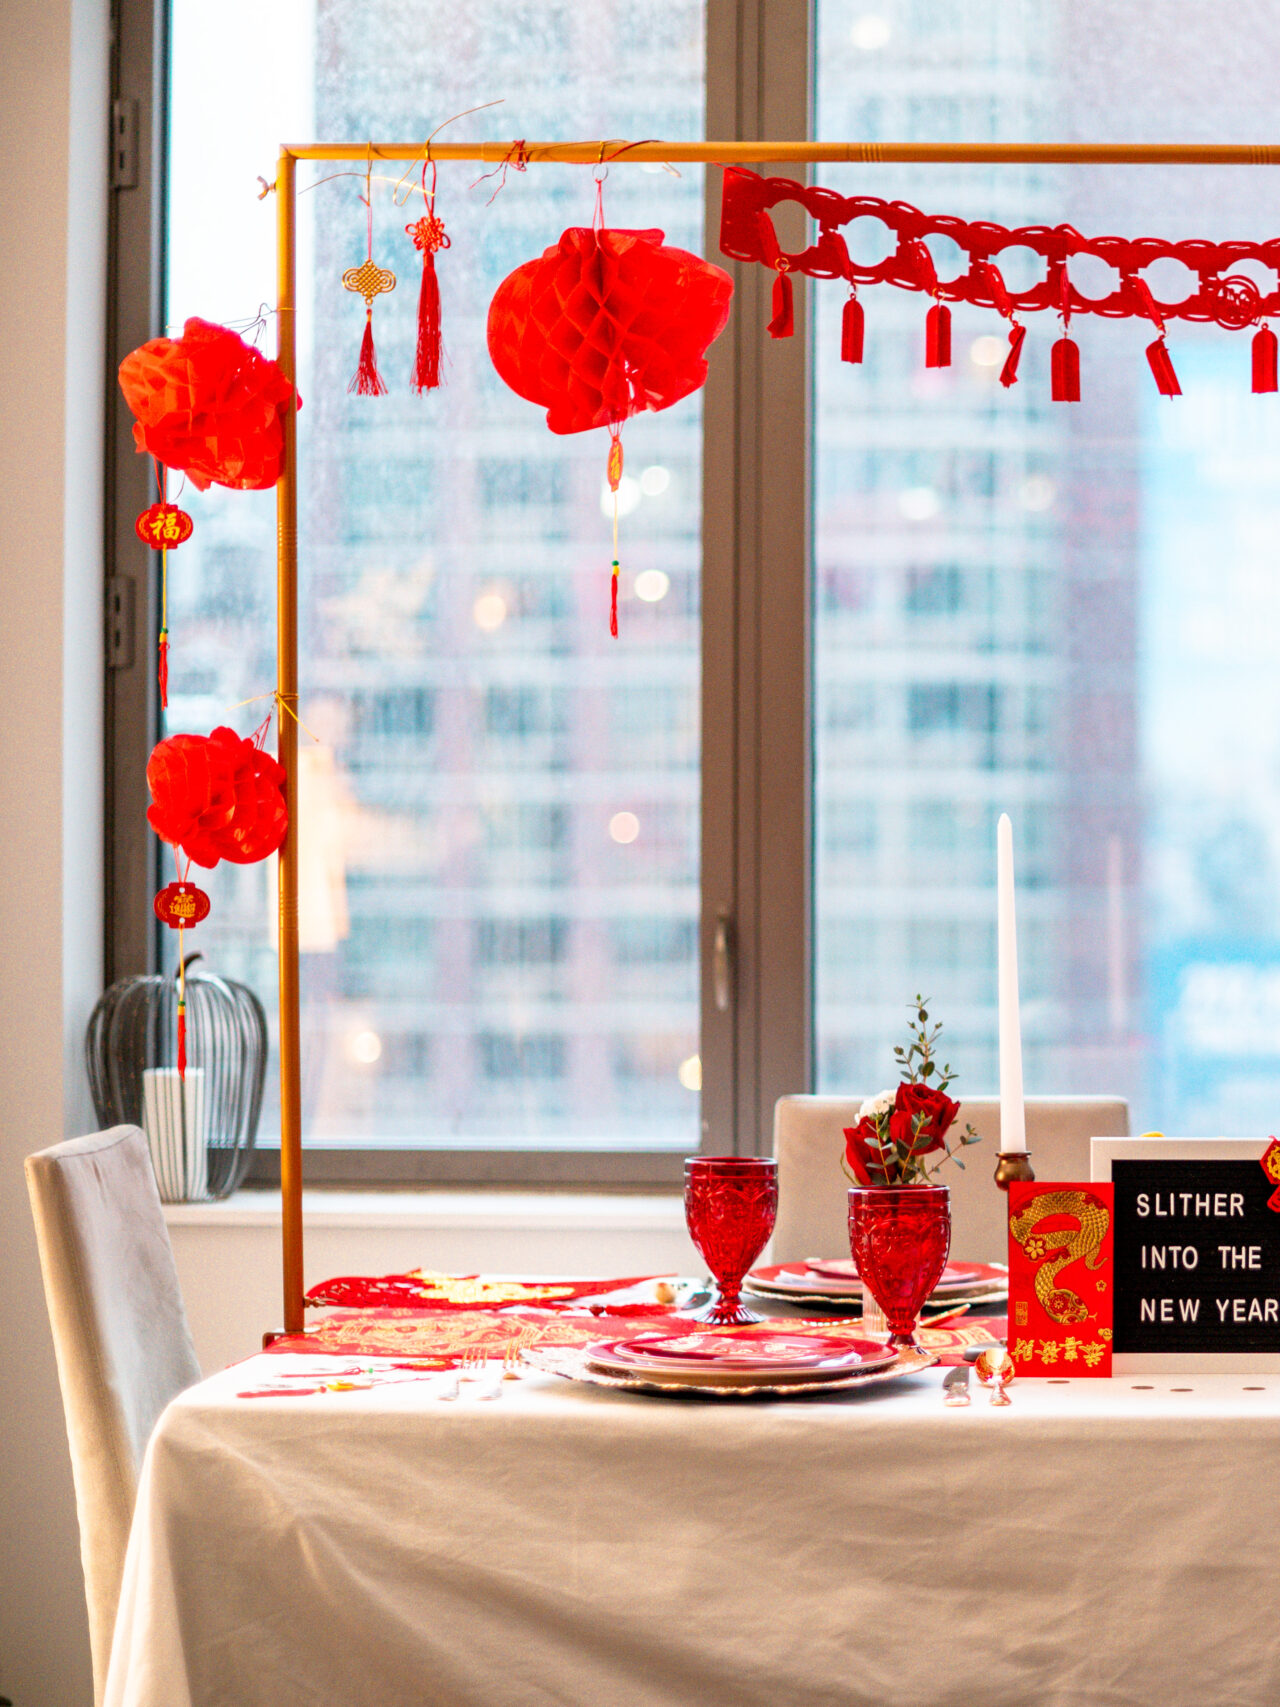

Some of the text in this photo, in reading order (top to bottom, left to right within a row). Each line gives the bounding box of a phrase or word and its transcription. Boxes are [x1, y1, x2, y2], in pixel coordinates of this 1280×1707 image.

[1136, 1193, 1244, 1217] SLITHER
[1141, 1245, 1262, 1270] INTO THE
[1140, 1298, 1279, 1322] NEW YEAR
